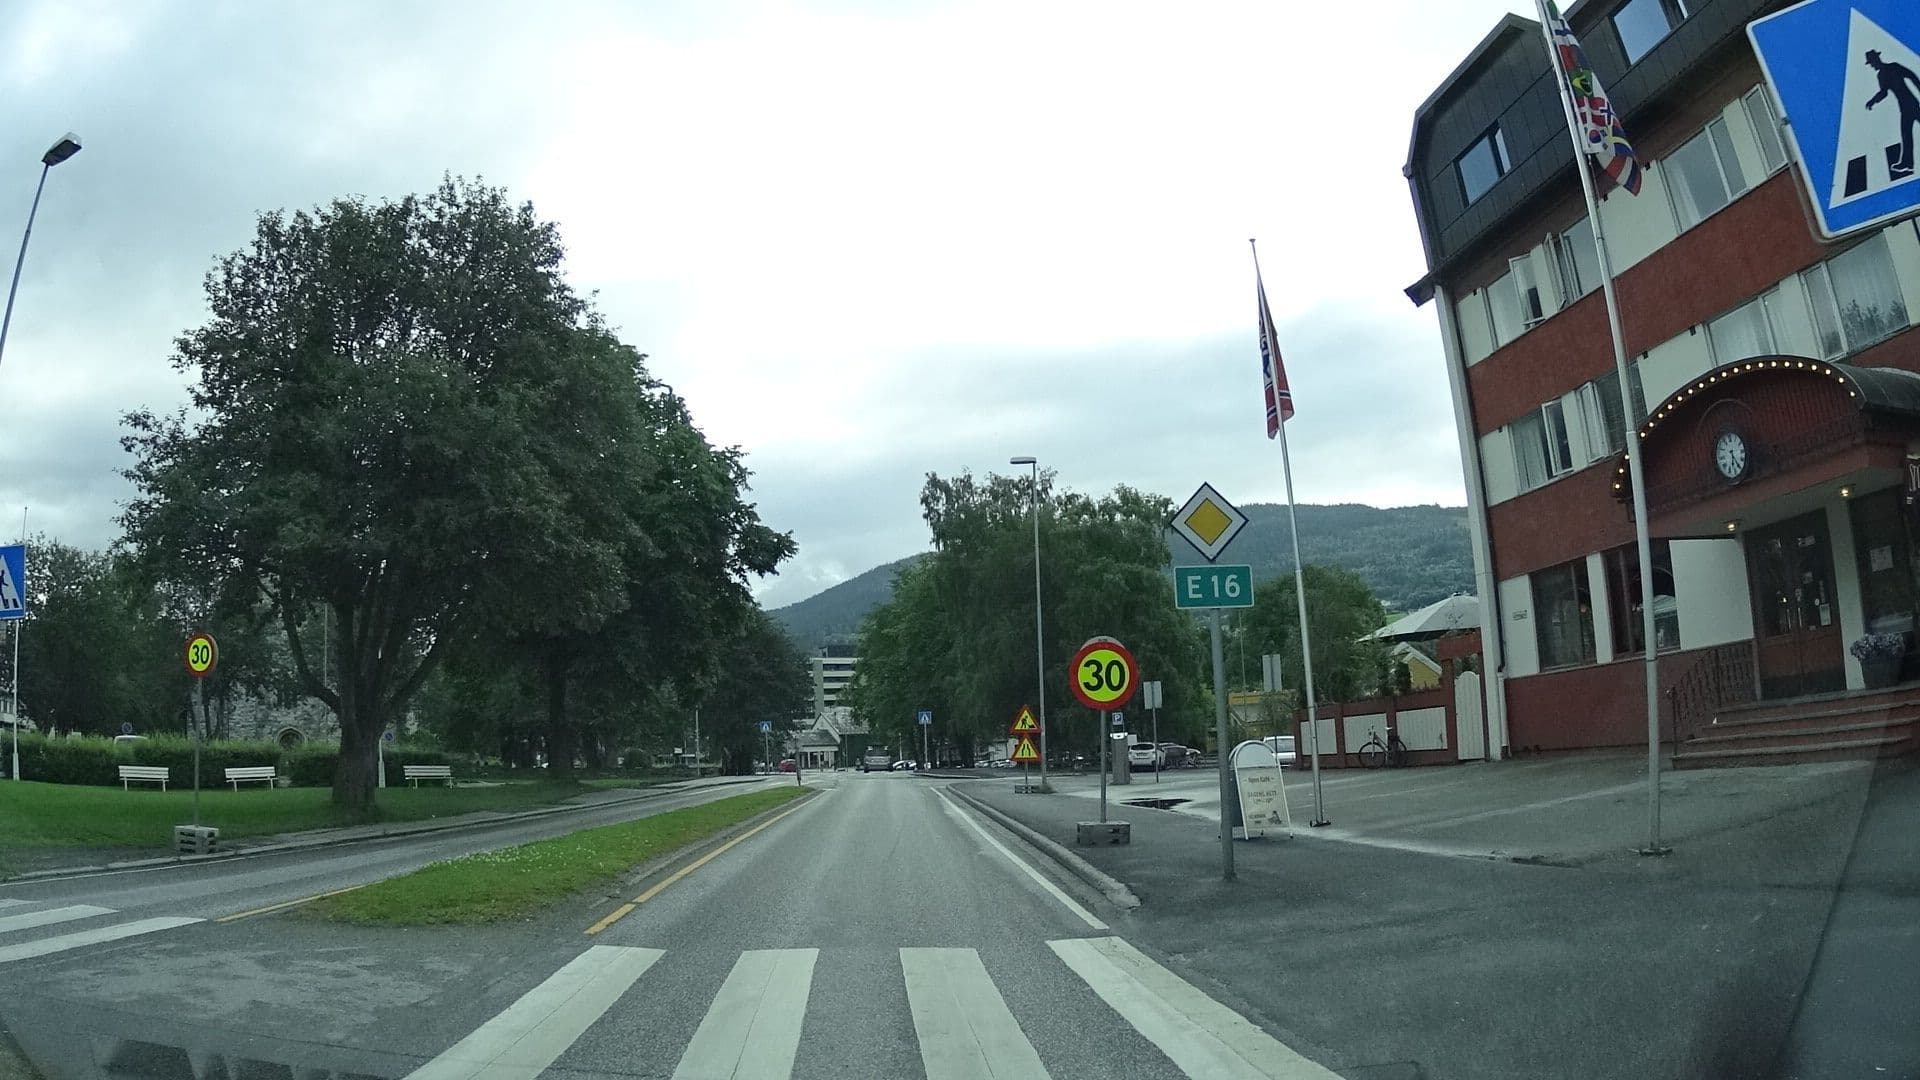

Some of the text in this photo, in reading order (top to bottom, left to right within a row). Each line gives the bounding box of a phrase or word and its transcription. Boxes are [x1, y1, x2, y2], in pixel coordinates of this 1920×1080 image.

[1187, 574, 1240, 598] E 16
[191, 644, 210, 664] 30
[1083, 659, 1125, 691] 30
